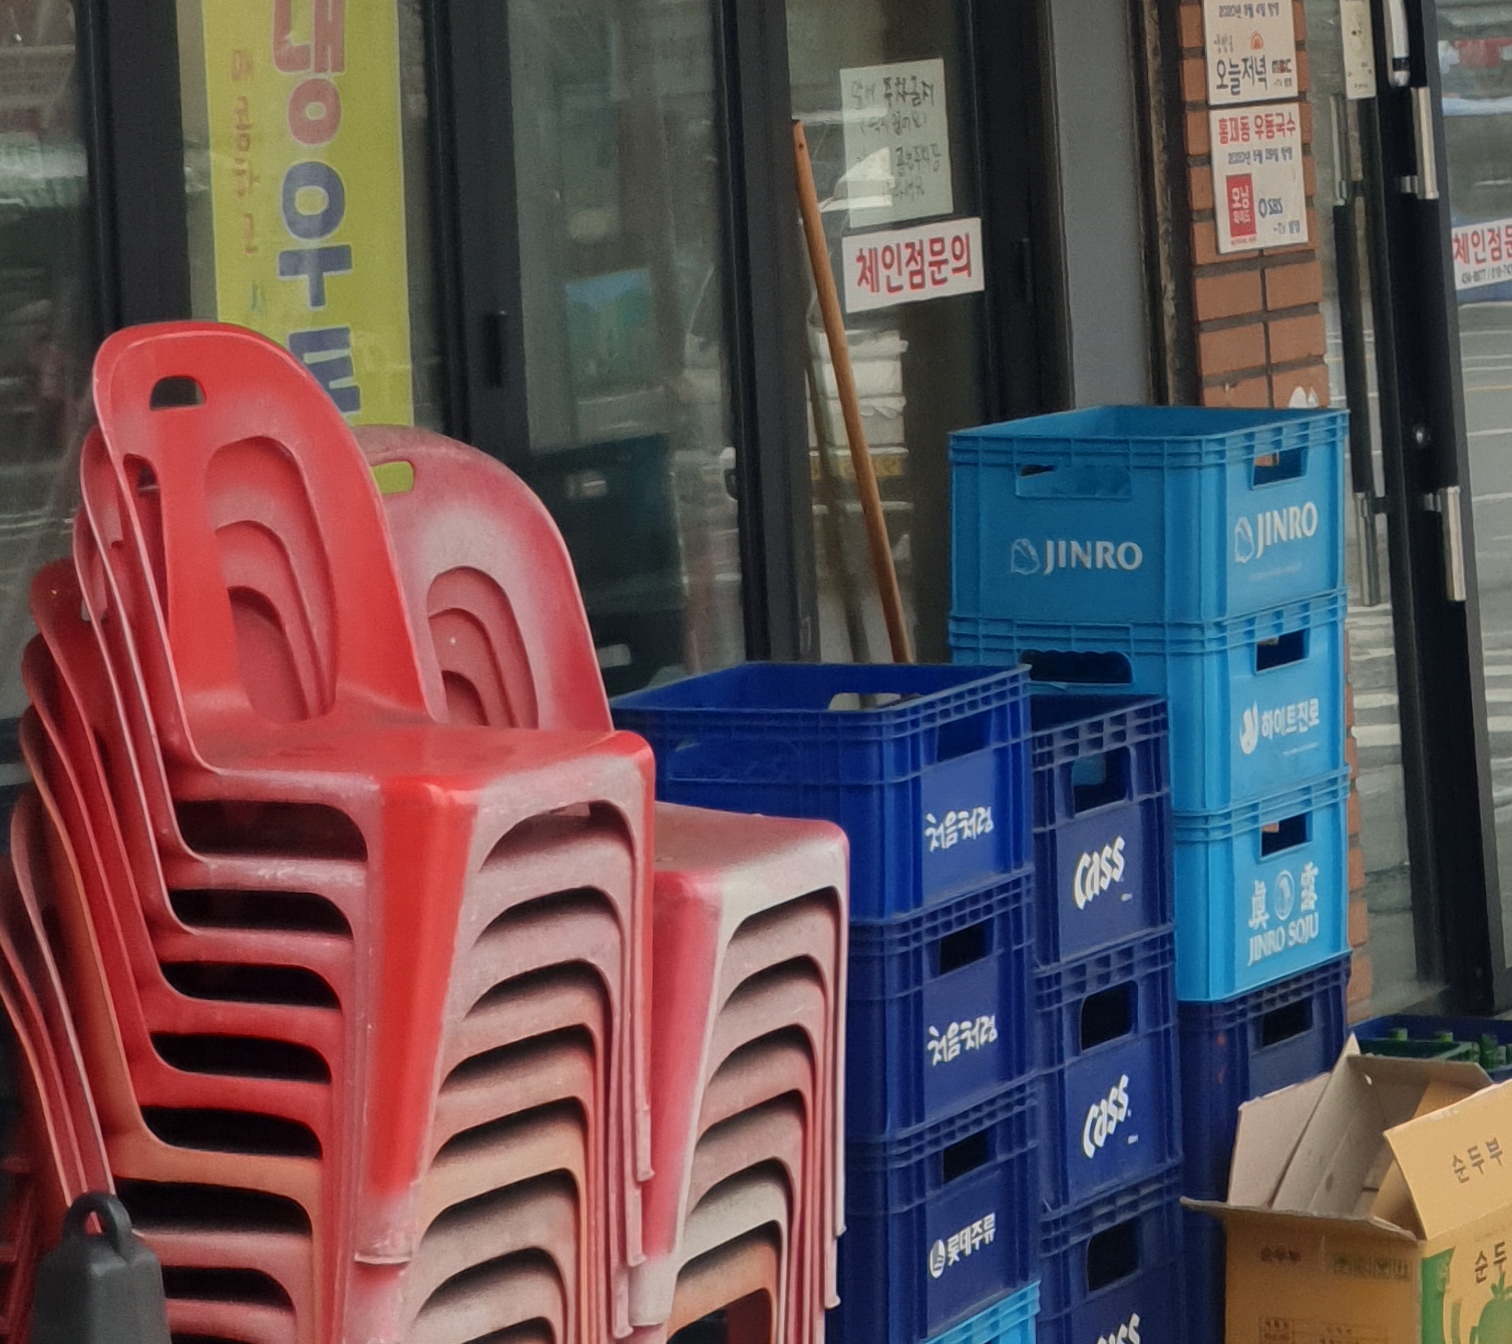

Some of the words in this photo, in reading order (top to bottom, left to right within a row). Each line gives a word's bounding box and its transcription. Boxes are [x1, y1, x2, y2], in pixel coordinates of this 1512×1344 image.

[1216, 54, 1268, 96] 오늘저녁
[1254, 112, 1297, 141] 우동국수
[856, 233, 972, 294] 체인점문의
[1256, 501, 1319, 559] JINRO
[1044, 540, 1143, 575] JINRO
[1261, 698, 1320, 740] 하이트진로
[925, 806, 994, 852] 처음처럼
[1073, 835, 1126, 911] Cass
[1248, 925, 1286, 967] JINRO
[1287, 912, 1320, 947] SOJU
[927, 1015, 998, 1066] 처음처럼
[1082, 1074, 1130, 1159] Cass
[1452, 1137, 1504, 1185] 순두부
[947, 1212, 997, 1267] 롯데주류
